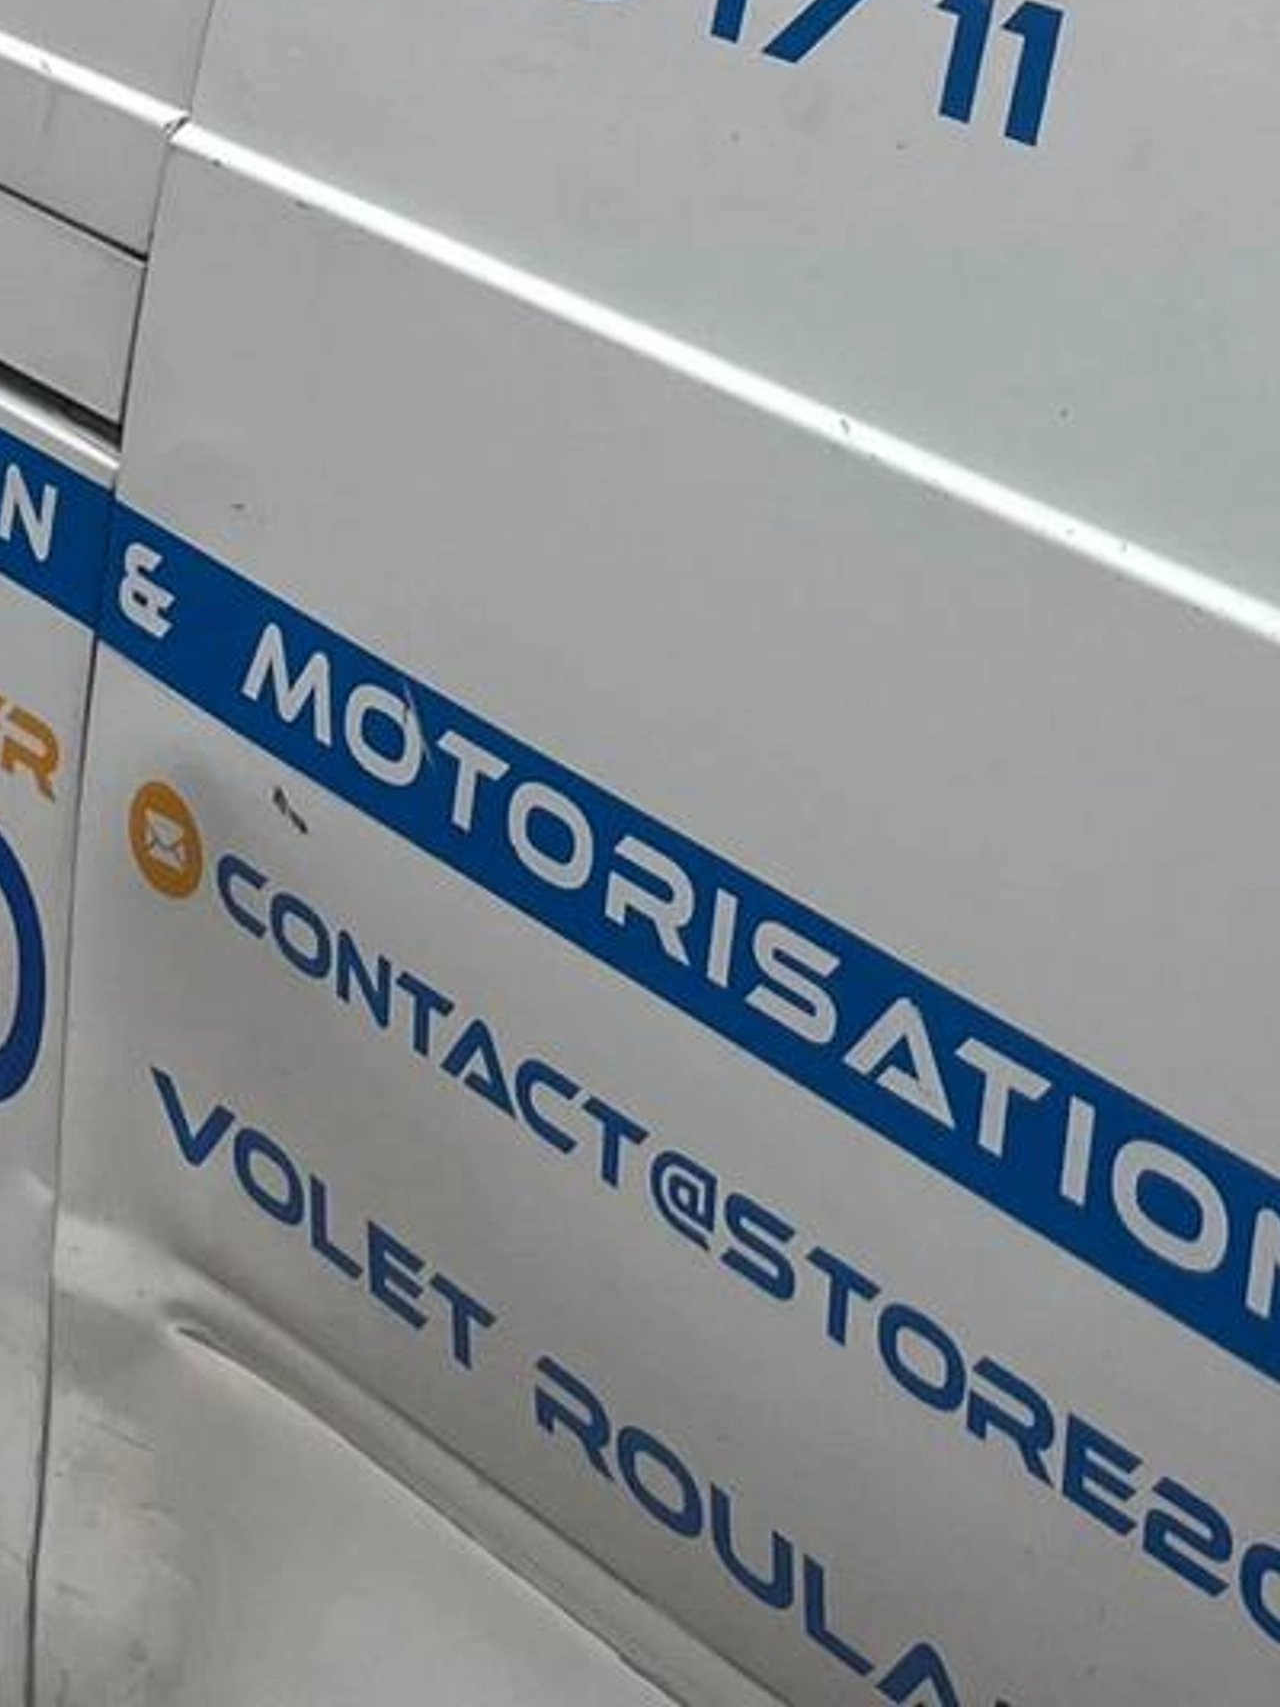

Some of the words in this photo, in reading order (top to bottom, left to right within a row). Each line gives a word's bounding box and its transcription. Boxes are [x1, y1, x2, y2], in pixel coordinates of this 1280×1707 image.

[120, 543, 175, 638] &
[150, 1065, 497, 1371] VOLET
[533, 1354, 1012, 1707] ROULA
